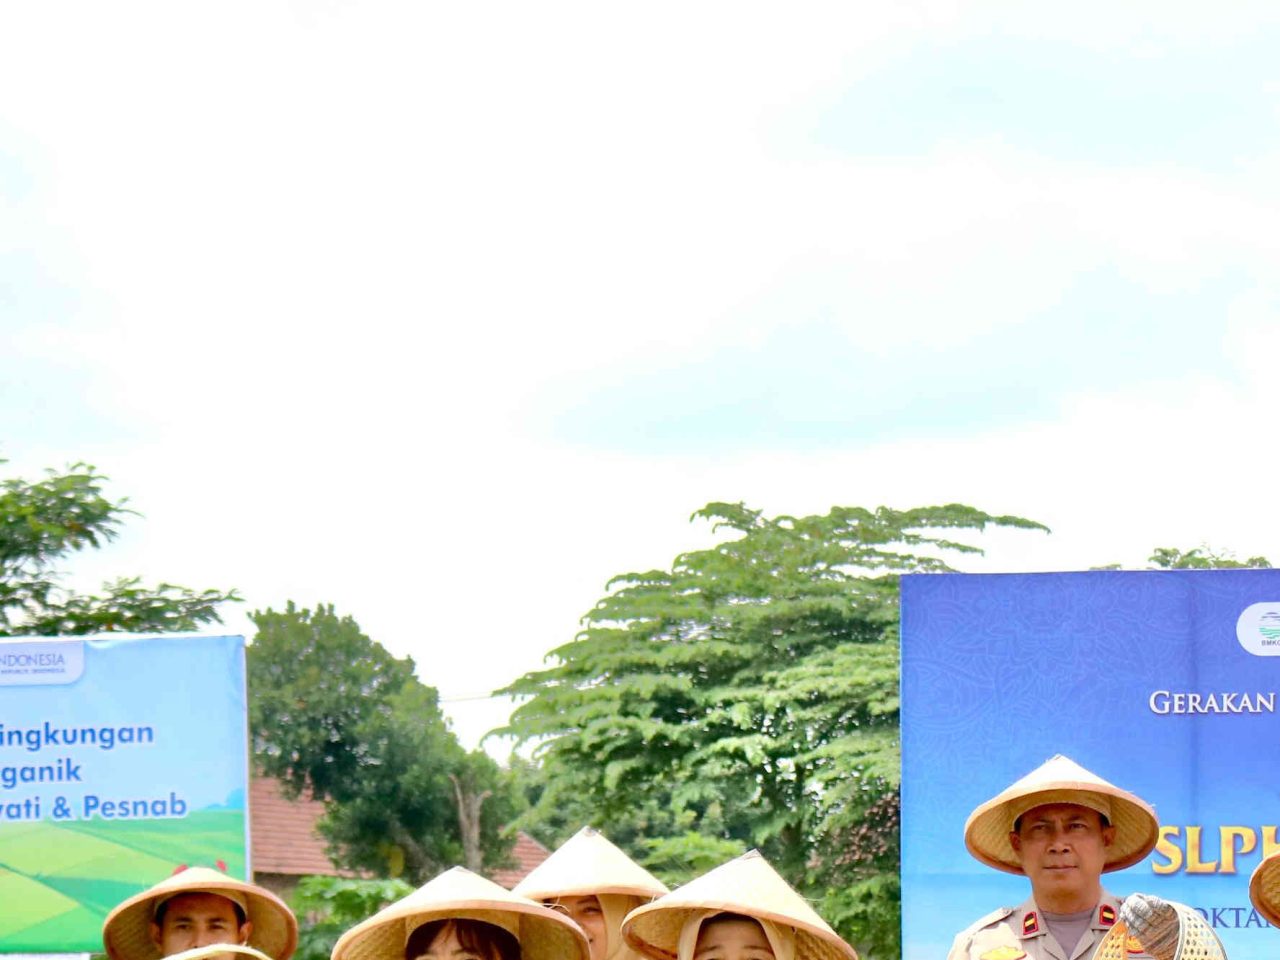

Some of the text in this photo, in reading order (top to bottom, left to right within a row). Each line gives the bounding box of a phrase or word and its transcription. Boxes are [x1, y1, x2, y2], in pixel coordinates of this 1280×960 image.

[1149, 690, 1275, 714] GERAKAN
[53, 796, 71, 818] &
[84, 792, 187, 818] Pesnab
